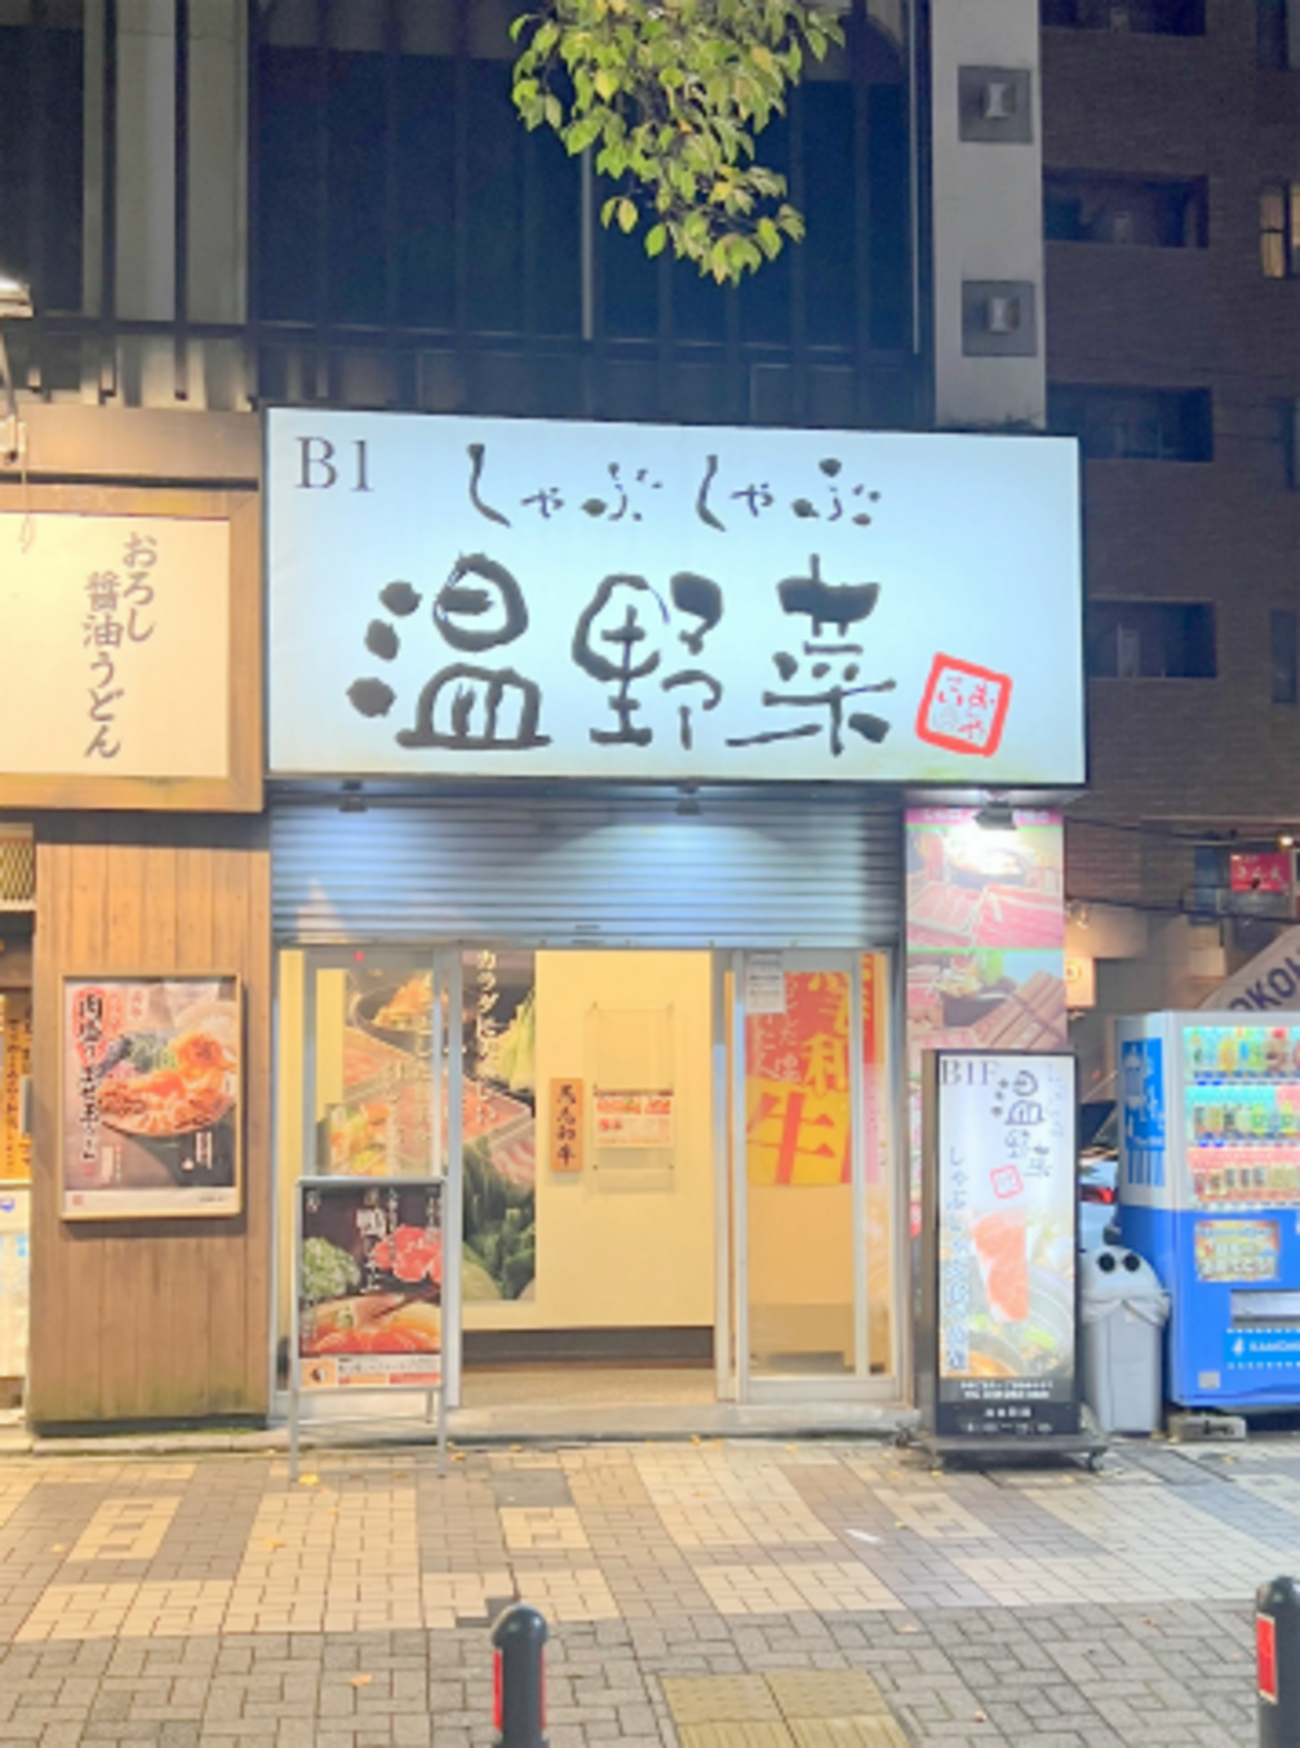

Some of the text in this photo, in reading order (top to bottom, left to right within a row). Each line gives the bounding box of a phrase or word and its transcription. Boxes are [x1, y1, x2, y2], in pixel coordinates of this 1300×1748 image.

[296, 436, 374, 490] B1
[466, 443, 881, 530] しゃぶしゃぶ
[122, 531, 158, 642] おろし
[81, 569, 125, 759] 醤油うどん
[347, 552, 897, 756] 温野菜
